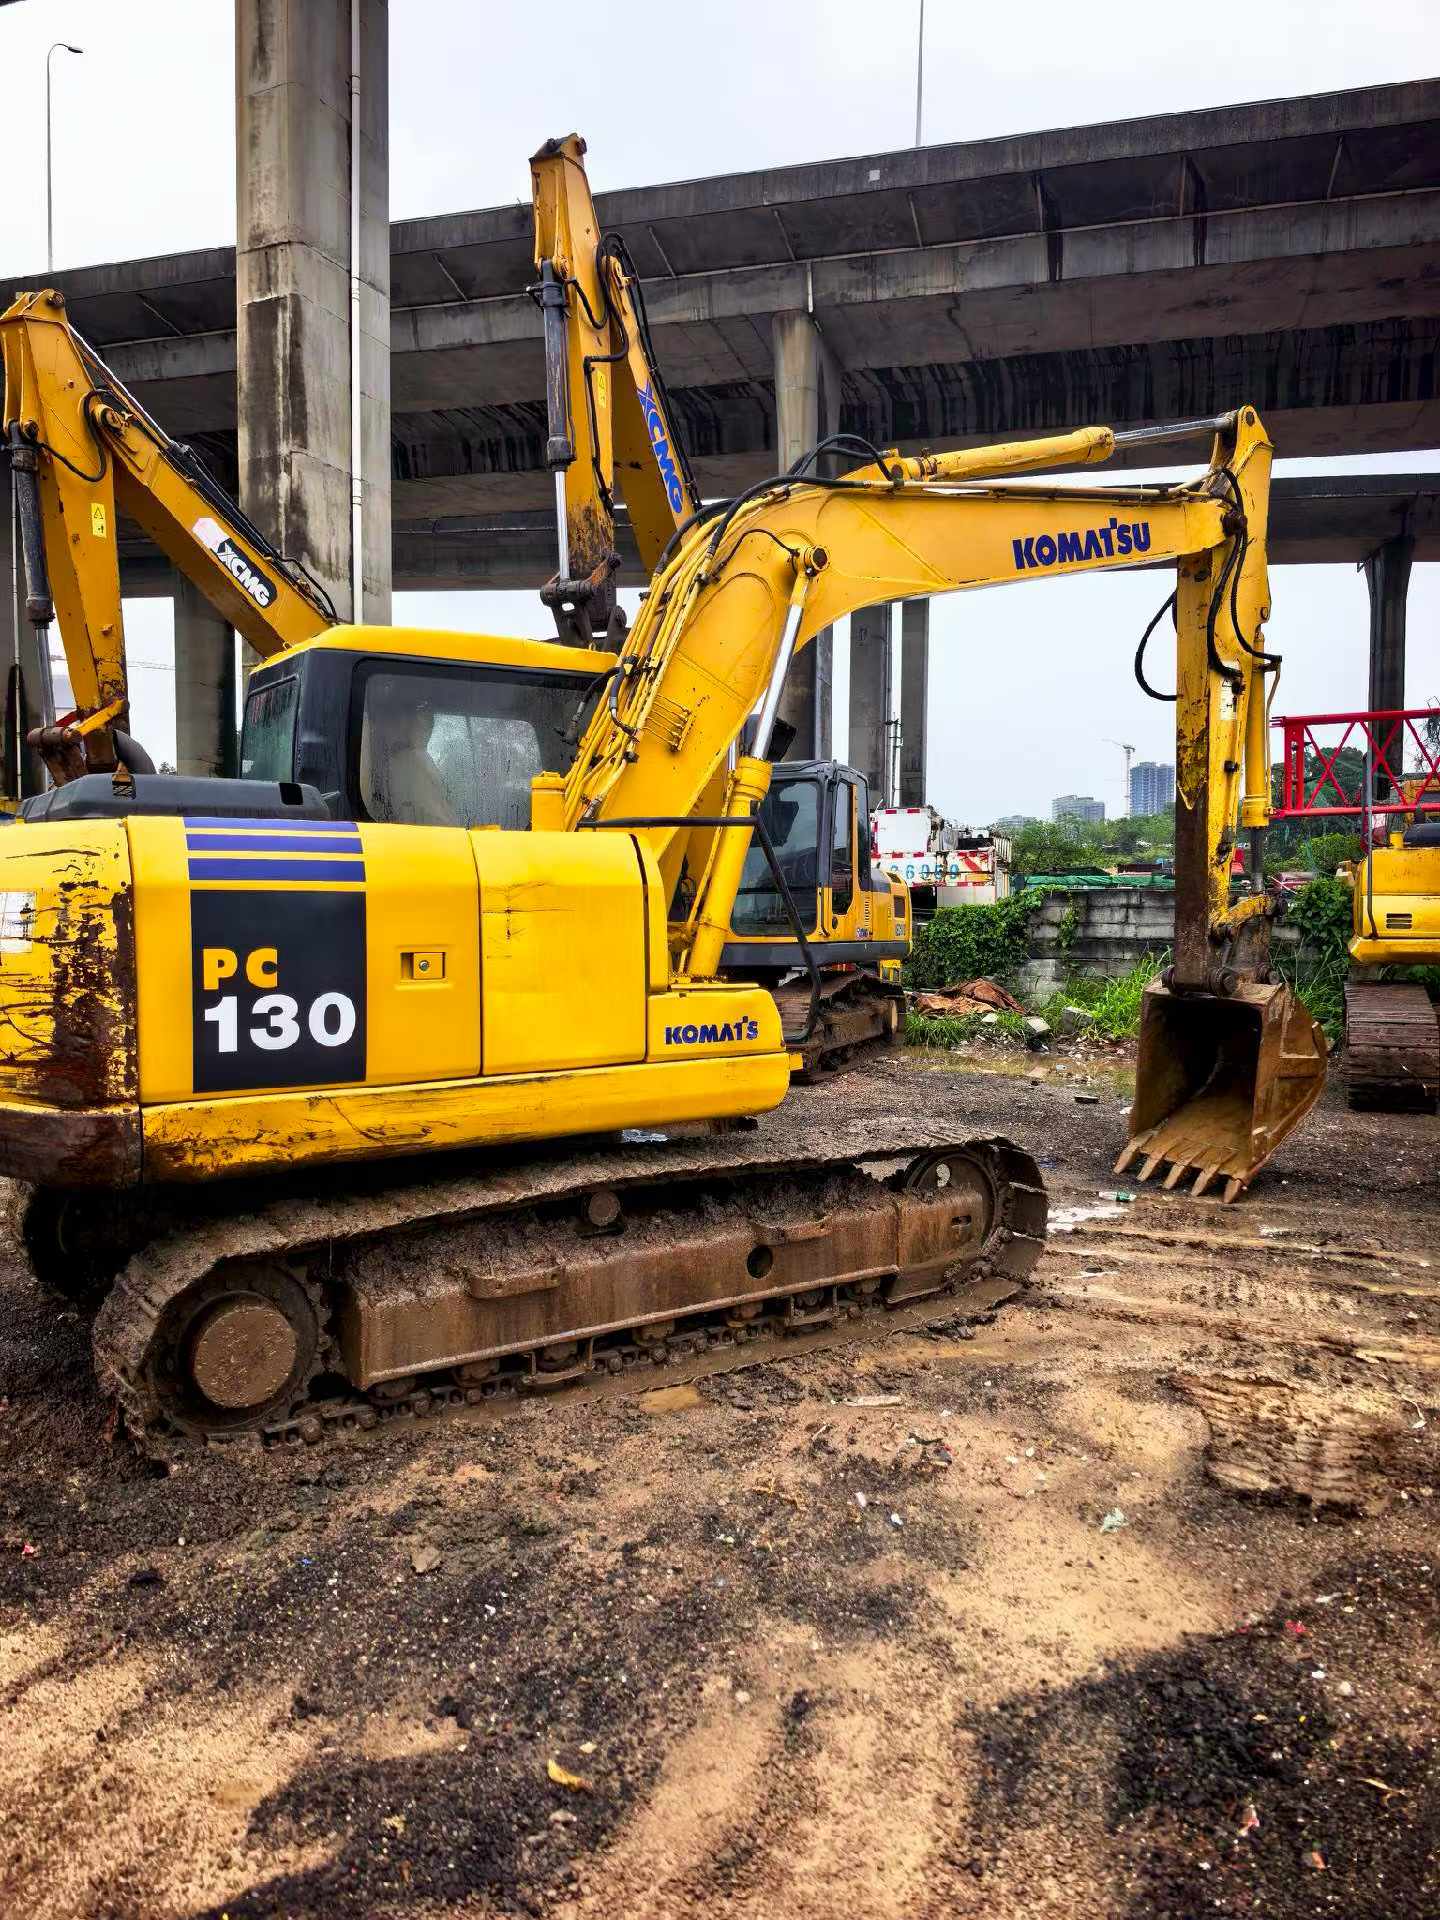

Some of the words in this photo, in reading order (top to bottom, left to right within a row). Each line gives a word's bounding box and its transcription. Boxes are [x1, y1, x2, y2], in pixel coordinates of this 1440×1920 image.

[637, 381, 683, 513] XCMG
[217, 541, 270, 607] XCMG
[1012, 517, 1151, 570] KOMATSU
[203, 947, 278, 990] PC
[204, 991, 356, 1053] 130
